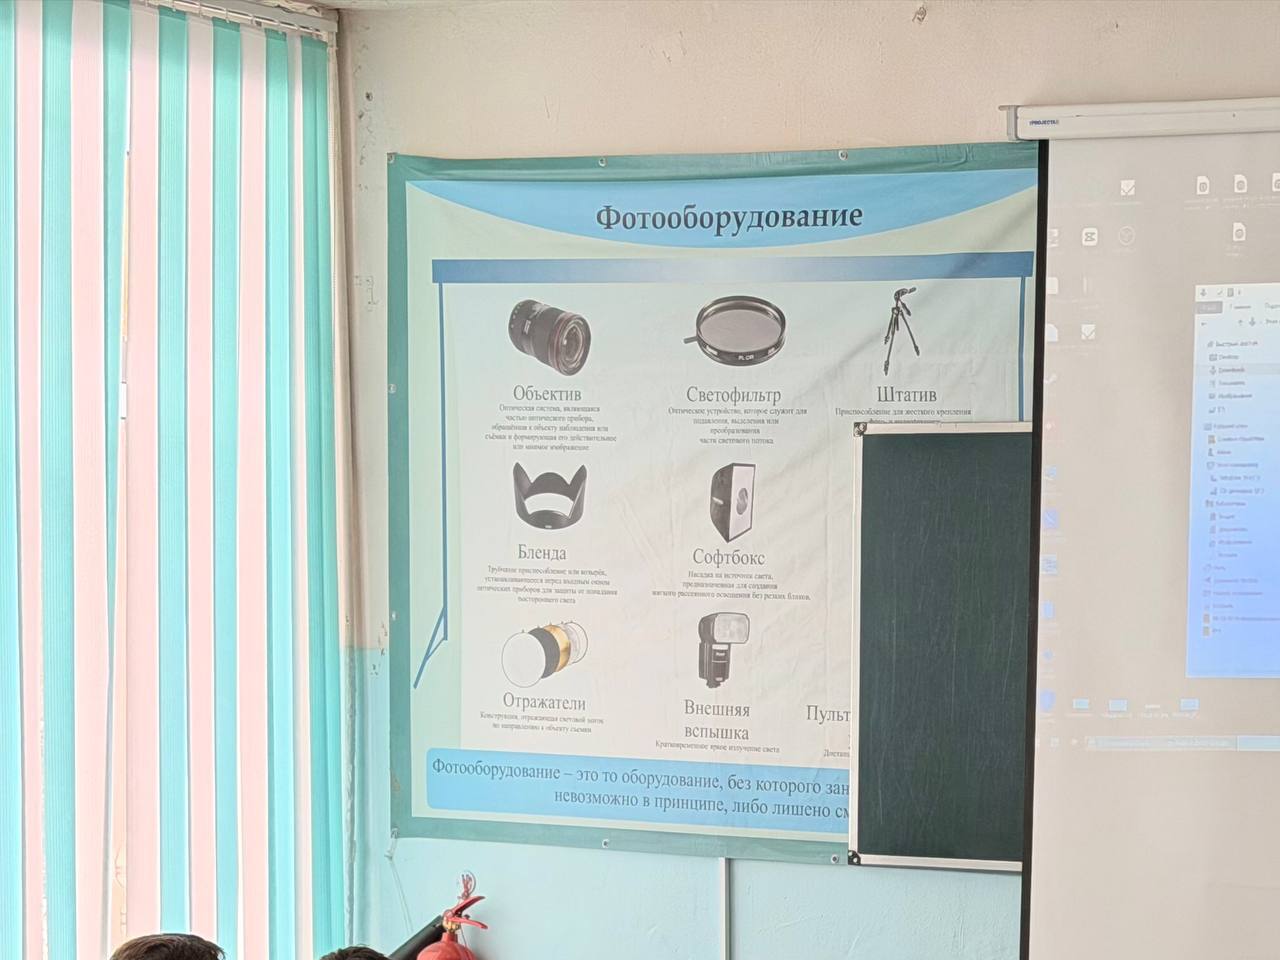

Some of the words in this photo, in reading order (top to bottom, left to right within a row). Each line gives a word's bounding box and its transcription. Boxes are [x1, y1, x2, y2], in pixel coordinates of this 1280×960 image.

[596, 204, 863, 237] Фотооборудование
[513, 384, 582, 401] Объектив
[686, 386, 781, 406] Светофильтр
[877, 386, 937, 402] Штатив
[518, 543, 567, 561] Бленда
[692, 547, 765, 569] Софтбокс
[503, 692, 586, 712] Отражатели
[684, 699, 750, 717] Внешняя
[807, 704, 850, 725] Пульт
[685, 726, 749, 741] вспышка
[433, 757, 560, 780] Фотооборудование
[576, 769, 598, 781] это
[604, 772, 618, 783] то
[622, 768, 723, 790] оборудование,
[728, 773, 751, 790] без
[756, 779, 821, 796] которого
[554, 790, 639, 807] невозможно
[643, 797, 650, 806] в
[654, 796, 728, 814] принципе,
[732, 798, 768, 814] либо
[772, 803, 830, 818] лишено
